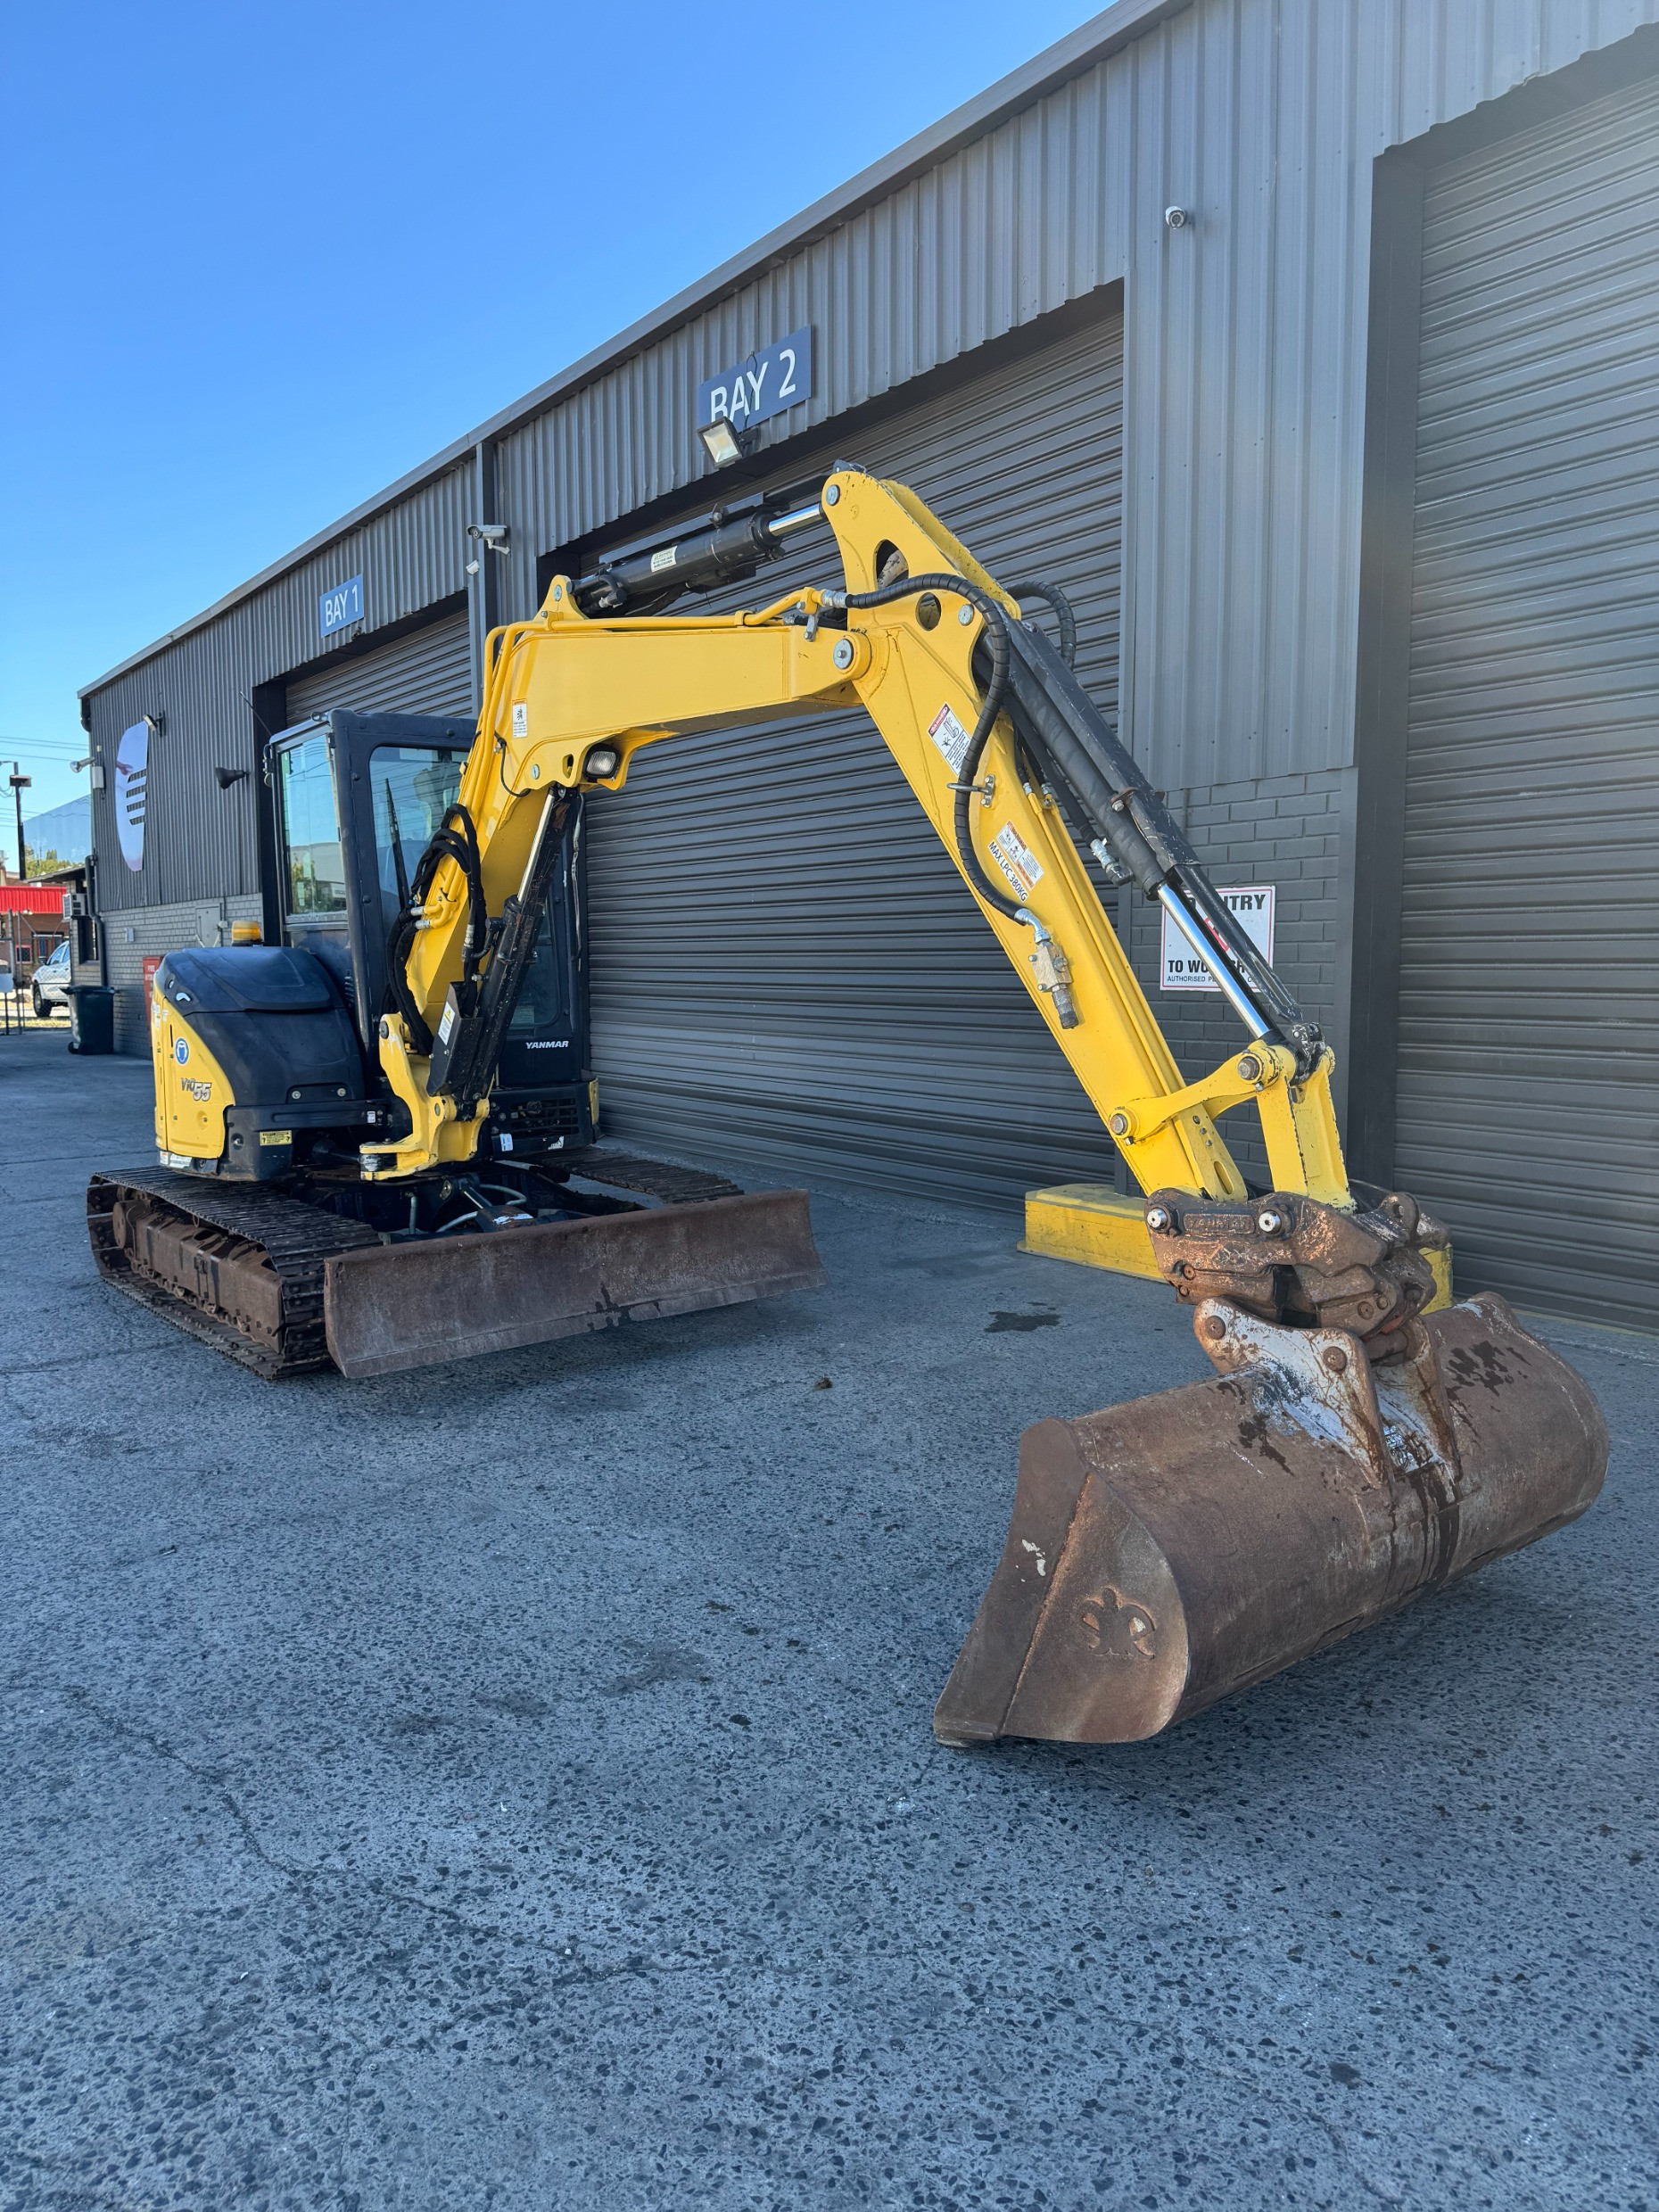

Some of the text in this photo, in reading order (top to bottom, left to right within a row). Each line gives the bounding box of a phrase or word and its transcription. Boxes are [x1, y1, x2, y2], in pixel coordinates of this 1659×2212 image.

[711, 349, 796, 423] BAY 2
[325, 584, 359, 628] BAY 1
[988, 841, 1003, 863] MAX
[1000, 859, 1013, 877] LPC
[1009, 874, 1028, 902] 380KG
[1222, 894, 1267, 911] TRY
[1168, 960, 1184, 973] TO
[525, 1040, 569, 1050] YANMAR
